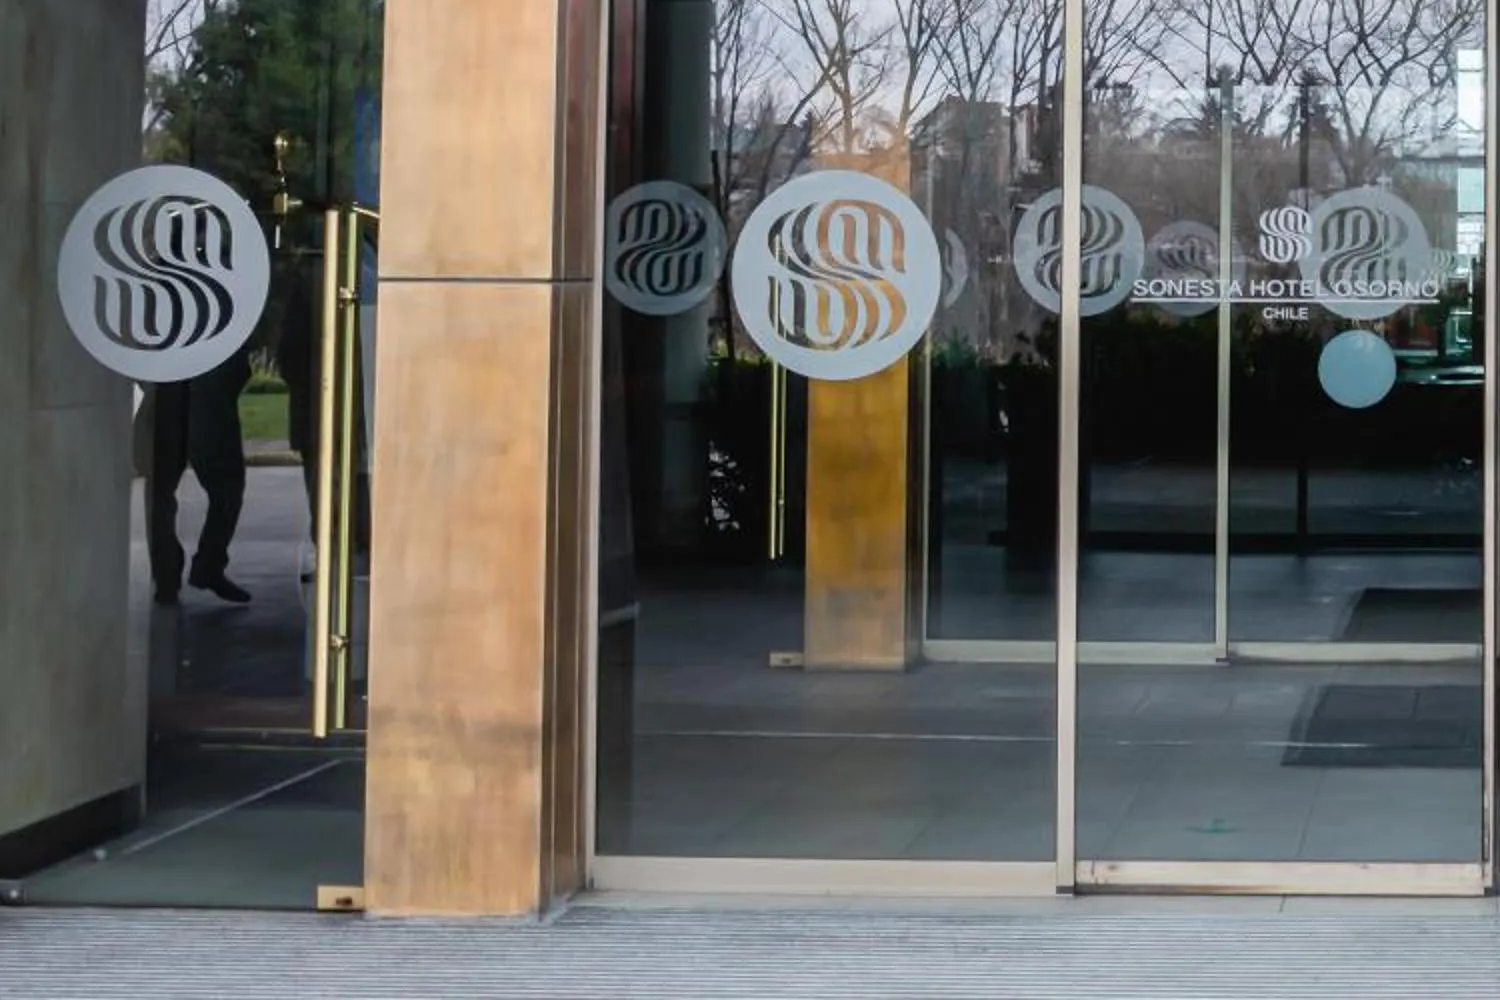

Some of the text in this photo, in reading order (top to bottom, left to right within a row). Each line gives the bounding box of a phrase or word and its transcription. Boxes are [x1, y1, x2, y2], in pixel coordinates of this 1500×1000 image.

[1133, 279, 1439, 297] SONESTA HOTEL OSORNO
[1263, 308, 1309, 321] CHILE
